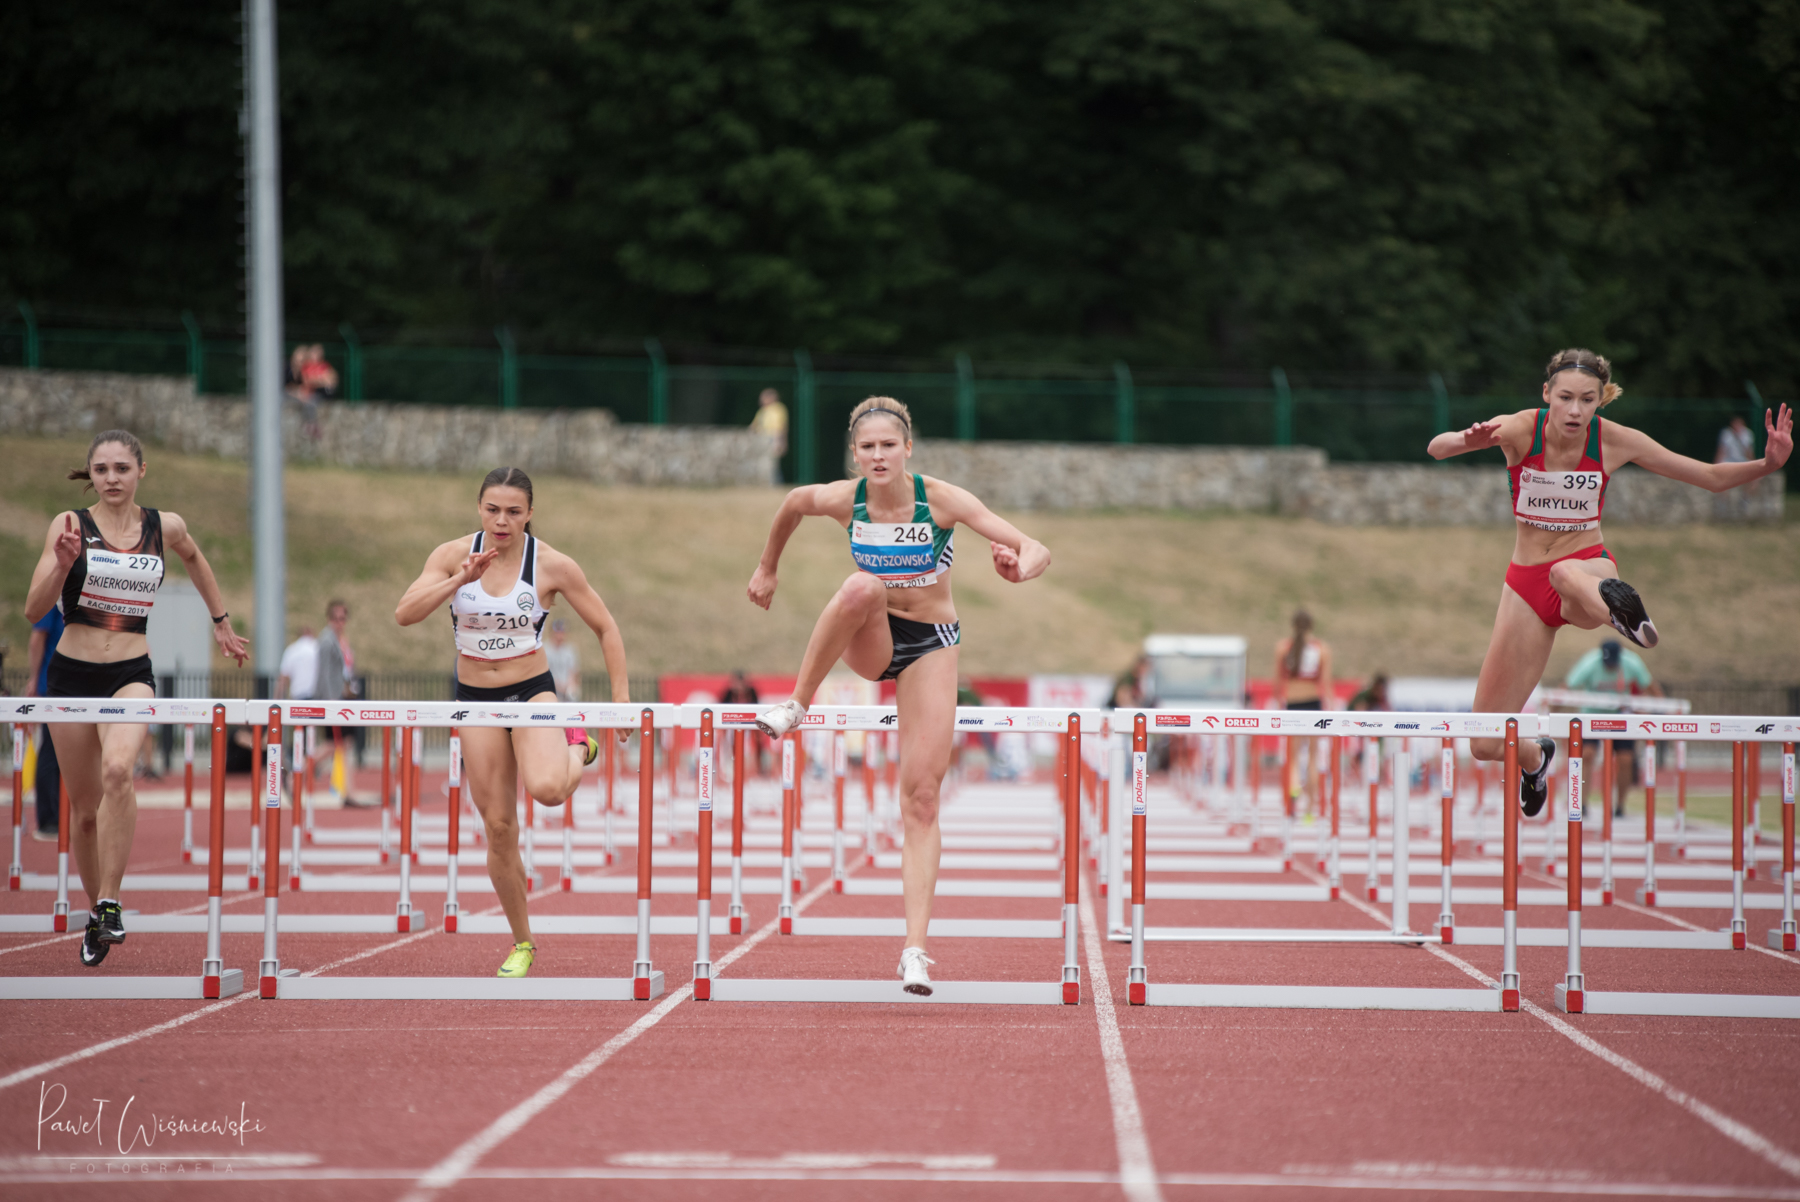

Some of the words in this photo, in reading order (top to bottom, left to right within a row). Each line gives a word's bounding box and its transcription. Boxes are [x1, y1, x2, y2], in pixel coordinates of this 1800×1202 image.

[1563, 475, 1597, 490] 395
[1528, 497, 1588, 510] KIRYLUK
[894, 527, 928, 542] 246
[91, 556, 120, 565] 4MOVE
[129, 557, 158, 571] 297
[854, 552, 932, 567] SKRZYSZOWSKA
[87, 575, 155, 593] SKIERKOWSKA
[907, 577, 926, 587] 2019
[87, 600, 126, 612] RACIBÓRZ
[497, 615, 528, 629] 210
[479, 638, 515, 650] OZGA
[16, 704, 35, 714] 4F
[450, 711, 469, 720] 4F
[801, 716, 823, 724] RLEN
[879, 715, 897, 724] 4F
[1314, 719, 1333, 729] 4F
[1664, 724, 1696, 732] ORLEN
[1755, 724, 1775, 734] 4F
[269, 761, 277, 796] polanik
[701, 764, 709, 799] polanik
[1135, 768, 1144, 803] polanik
[1571, 774, 1580, 809] polanik
